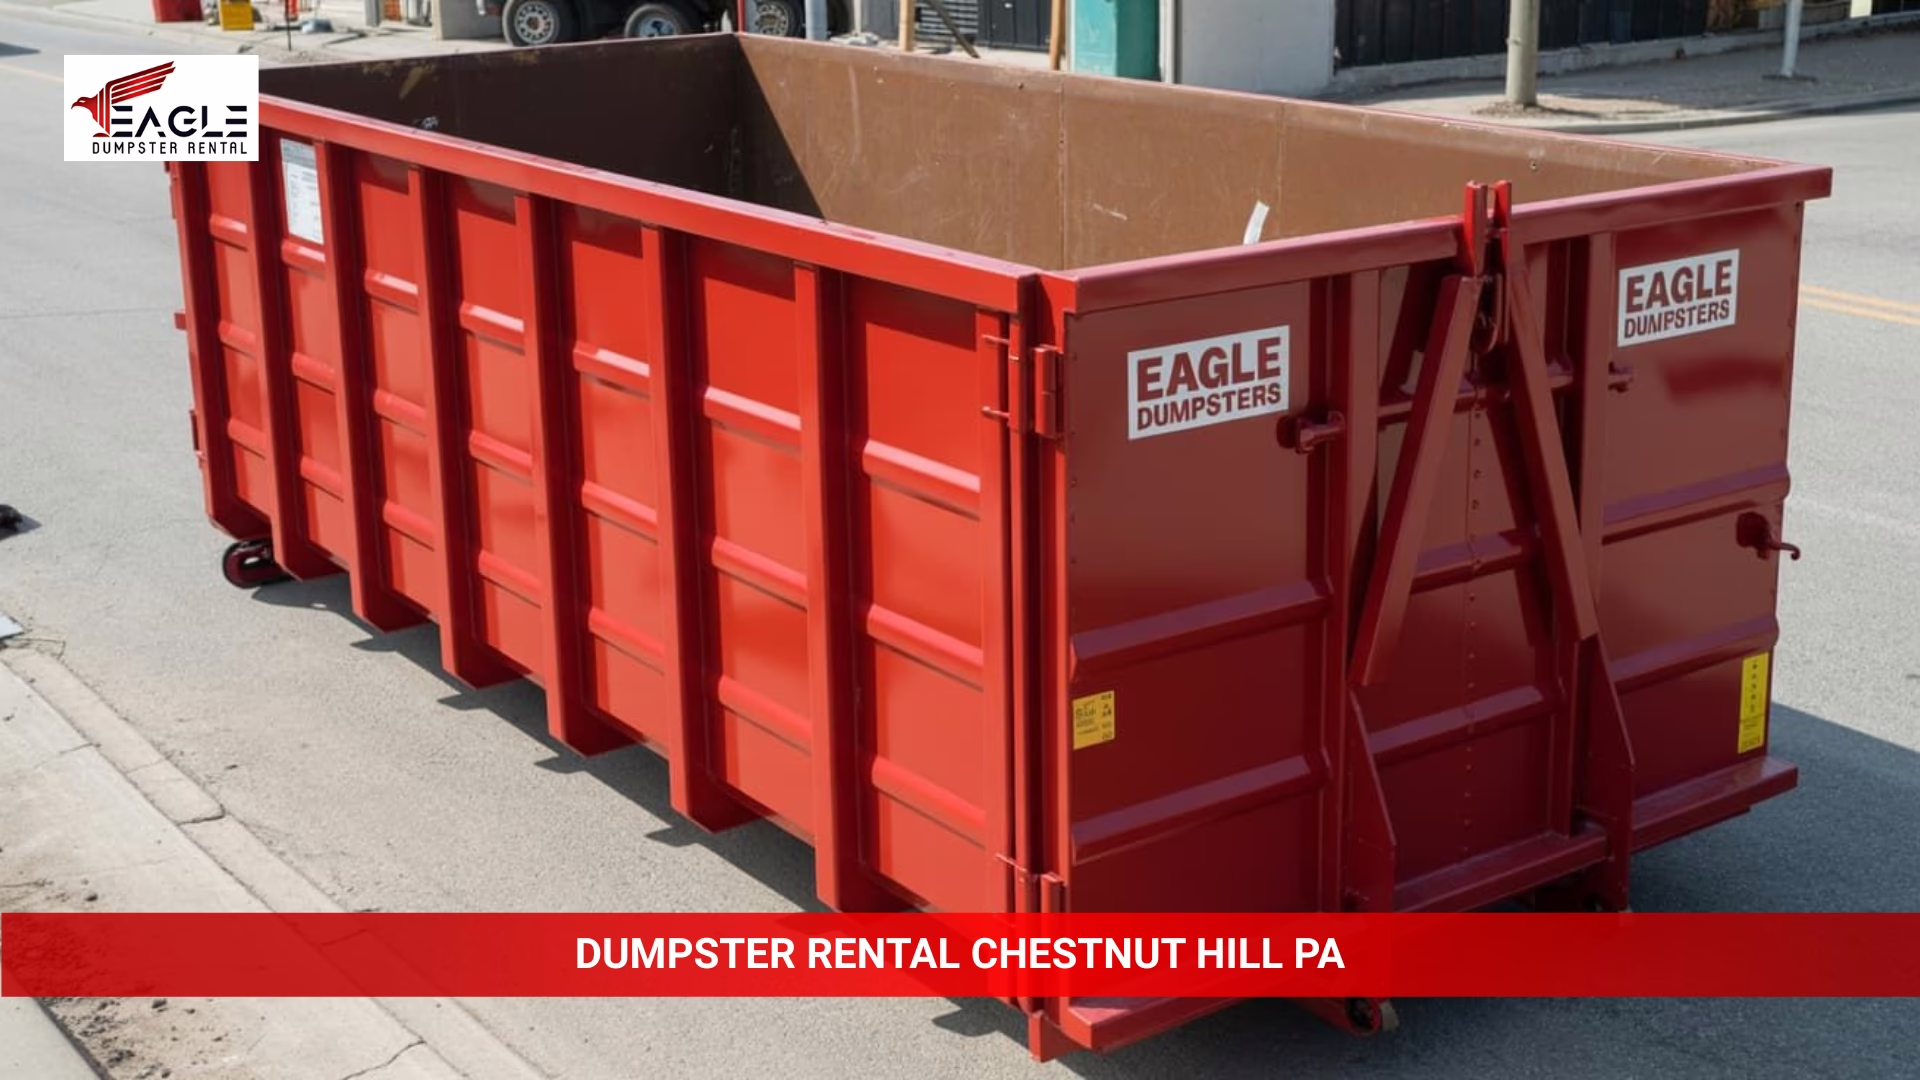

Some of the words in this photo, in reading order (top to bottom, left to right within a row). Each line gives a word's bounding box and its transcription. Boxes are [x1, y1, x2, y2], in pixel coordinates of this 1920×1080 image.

[1626, 259, 1733, 314] EAGLE
[1624, 299, 1730, 339] DUMPSTERS
[1137, 336, 1281, 403] EAGLE
[1137, 382, 1281, 431] DUMPSTERS
